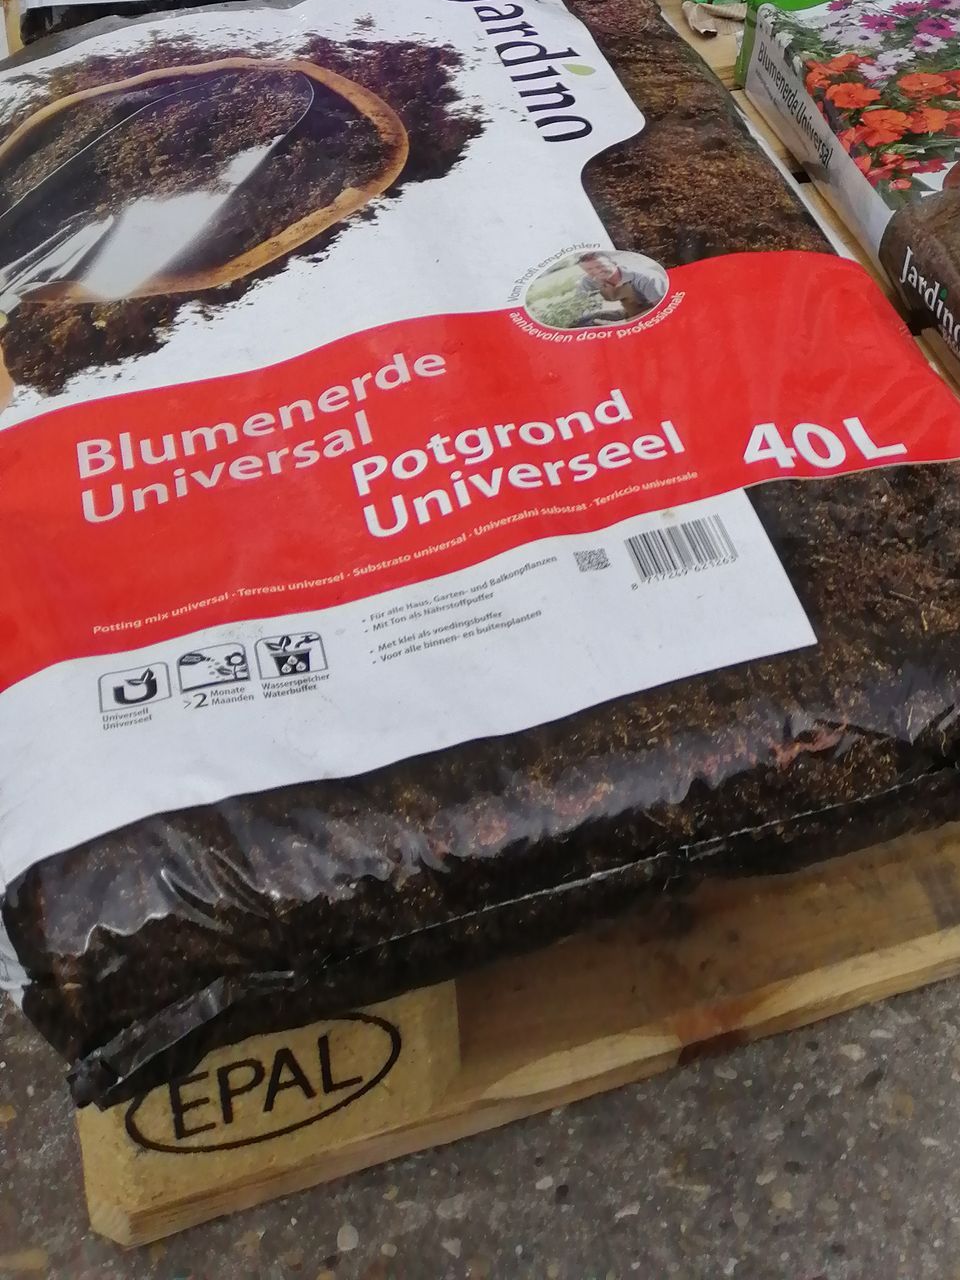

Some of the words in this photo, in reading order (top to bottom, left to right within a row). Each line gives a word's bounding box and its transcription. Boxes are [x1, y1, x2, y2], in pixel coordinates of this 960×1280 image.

[757, 41, 799, 116] Blumenerde
[796, 101, 834, 169] Universal
[507, 287, 520, 303] Vom
[519, 266, 539, 286] Profi
[537, 242, 601, 268] empfohlen
[509, 311, 573, 343] aanbevolen
[576, 330, 613, 342] door
[616, 290, 687, 339] professionals
[76, 349, 447, 480] Blumenerde
[350, 388, 633, 497] Potgrond
[740, 414, 909, 470] 40L
[81, 409, 375, 524] Universal
[362, 420, 684, 540] Universeel
[92, 619, 142, 635] Potting
[144, 612, 170, 625] mix
[170, 592, 230, 616] universal
[237, 583, 286, 598] Terreau
[287, 572, 345, 592] universel
[352, 553, 412, 577] Substrato
[412, 533, 467, 559] universal
[473, 507, 539, 536] Univerzalni
[539, 502, 588, 517] substrat
[593, 484, 641, 507] Terriccio
[641, 471, 699, 491] universale
[369, 610, 386, 623] Für
[386, 605, 404, 617] alle
[433, 588, 469, 604] Garten-
[470, 581, 488, 595] und
[488, 556, 558, 588] Balkonpflanzen
[372, 621, 388, 633] Mit
[389, 615, 407, 628] Ton
[408, 611, 423, 622] als
[423, 591, 495, 617] Nährstoffpuffer
[377, 639, 397, 652] Met
[397, 633, 417, 646] klei
[417, 628, 432, 640] als
[432, 610, 503, 636] voedingsbuffer
[380, 649, 403, 664] Voor
[403, 643, 423, 656] alle
[422, 633, 461, 650] binnen-
[462, 629, 475, 640] en
[476, 608, 543, 637] buitenplanten
[210, 686, 246, 698] Monate
[211, 693, 255, 707] Maanden
[261, 673, 331, 692] Wasserspeicher
[262, 683, 318, 700] Waterbuffer
[169, 1033, 363, 1141] EPAL
